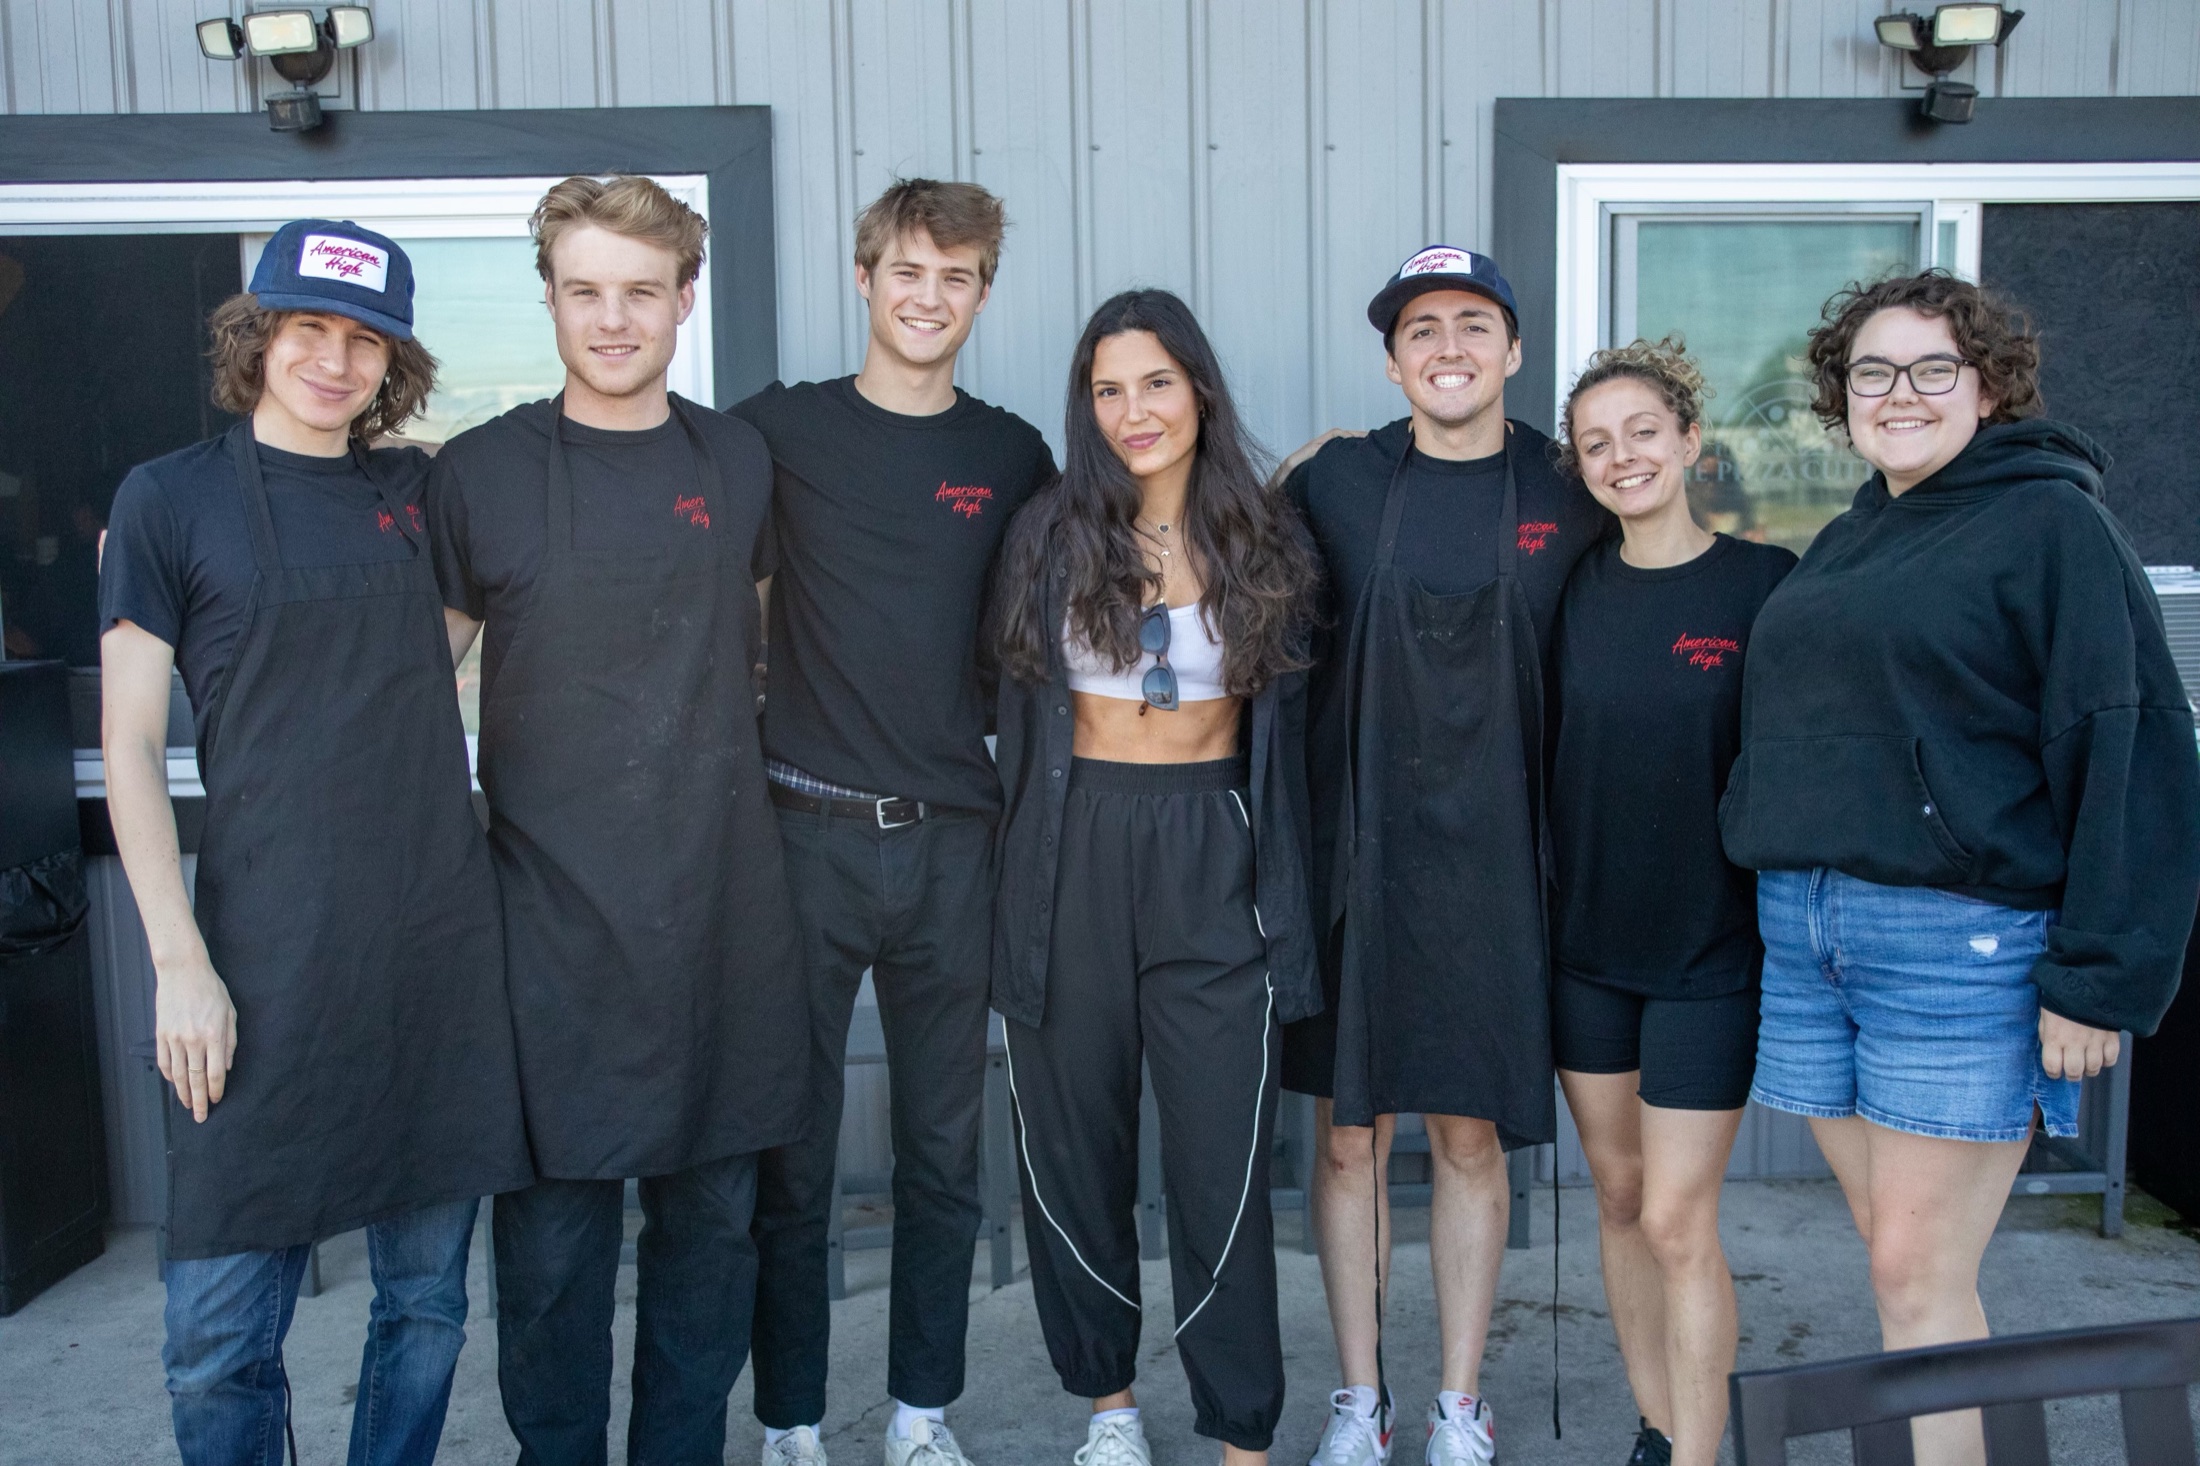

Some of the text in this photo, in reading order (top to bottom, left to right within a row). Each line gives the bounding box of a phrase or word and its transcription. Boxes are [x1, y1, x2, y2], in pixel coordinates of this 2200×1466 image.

[310, 240, 381, 267] American
[1405, 252, 1463, 274] American
[325, 257, 364, 277] High
[1416, 259, 1447, 274] High
[935, 481, 993, 502] American
[674, 494, 706, 517] Ameri
[953, 497, 982, 519] High
[691, 508, 710, 529] Hig
[1517, 521, 1559, 534] erican
[1517, 533, 1547, 556] High
[1672, 632, 1739, 654] American
[1689, 649, 1723, 671] High
